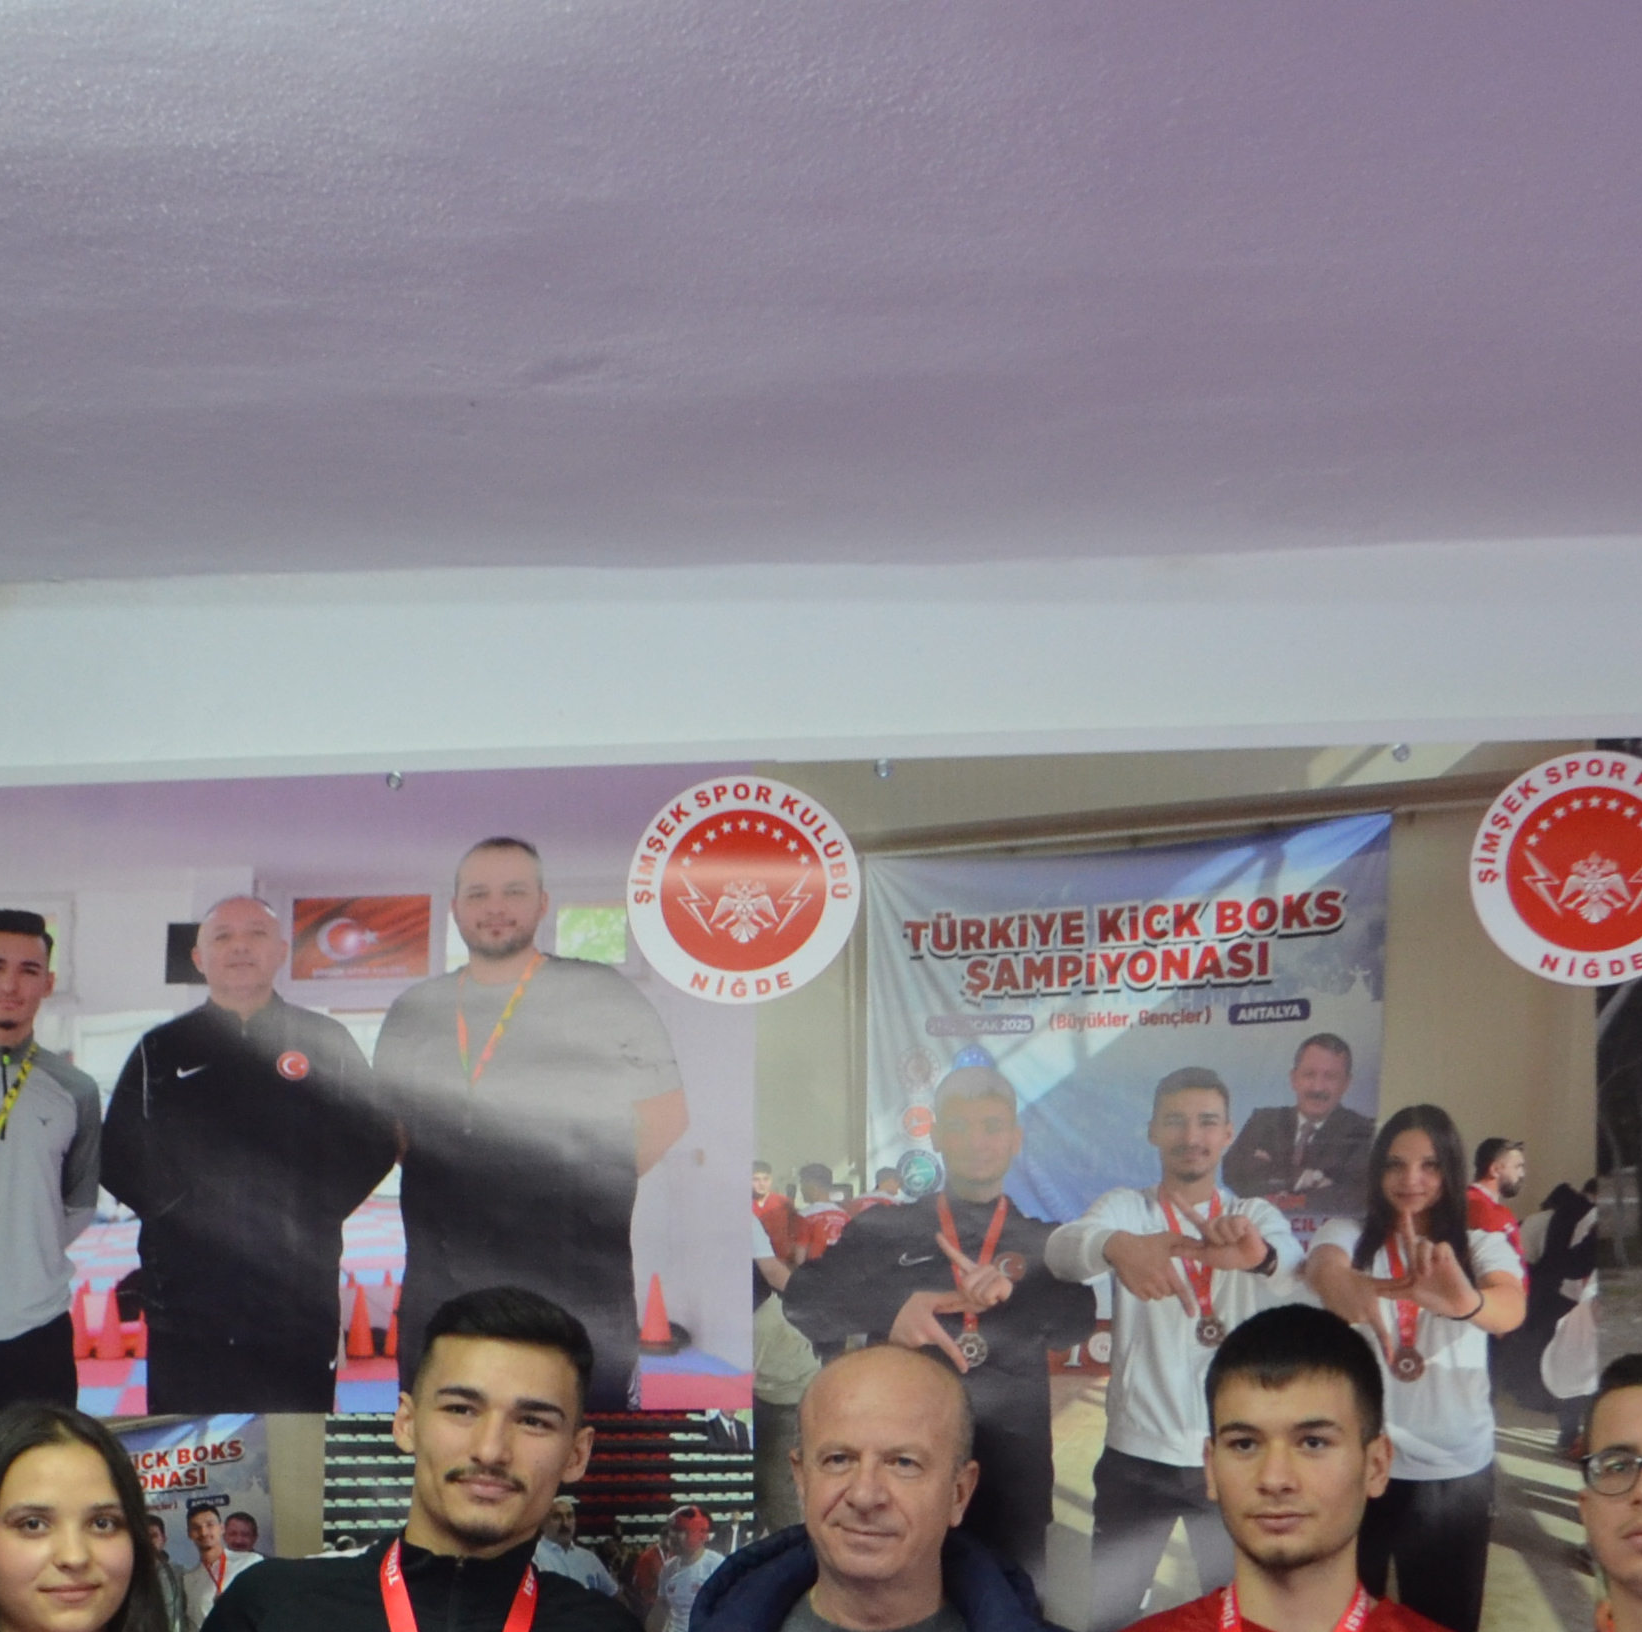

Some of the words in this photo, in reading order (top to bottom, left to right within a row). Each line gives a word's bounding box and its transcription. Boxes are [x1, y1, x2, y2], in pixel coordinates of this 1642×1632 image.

[1474, 779, 1540, 884] ŞİMŞEK
[1545, 759, 1626, 785] SPOR
[634, 803, 691, 905] ŞİMŞEK
[694, 783, 772, 808] SPOR
[780, 793, 853, 900] KULÜBÜ
[1216, 890, 1343, 935] BOKS
[690, 971, 792, 998] NİĞDE
[1001, 1017, 1032, 1031] 2025
[1237, 1004, 1301, 1022] ANTALYA
[177, 1439, 243, 1465] BOKS
